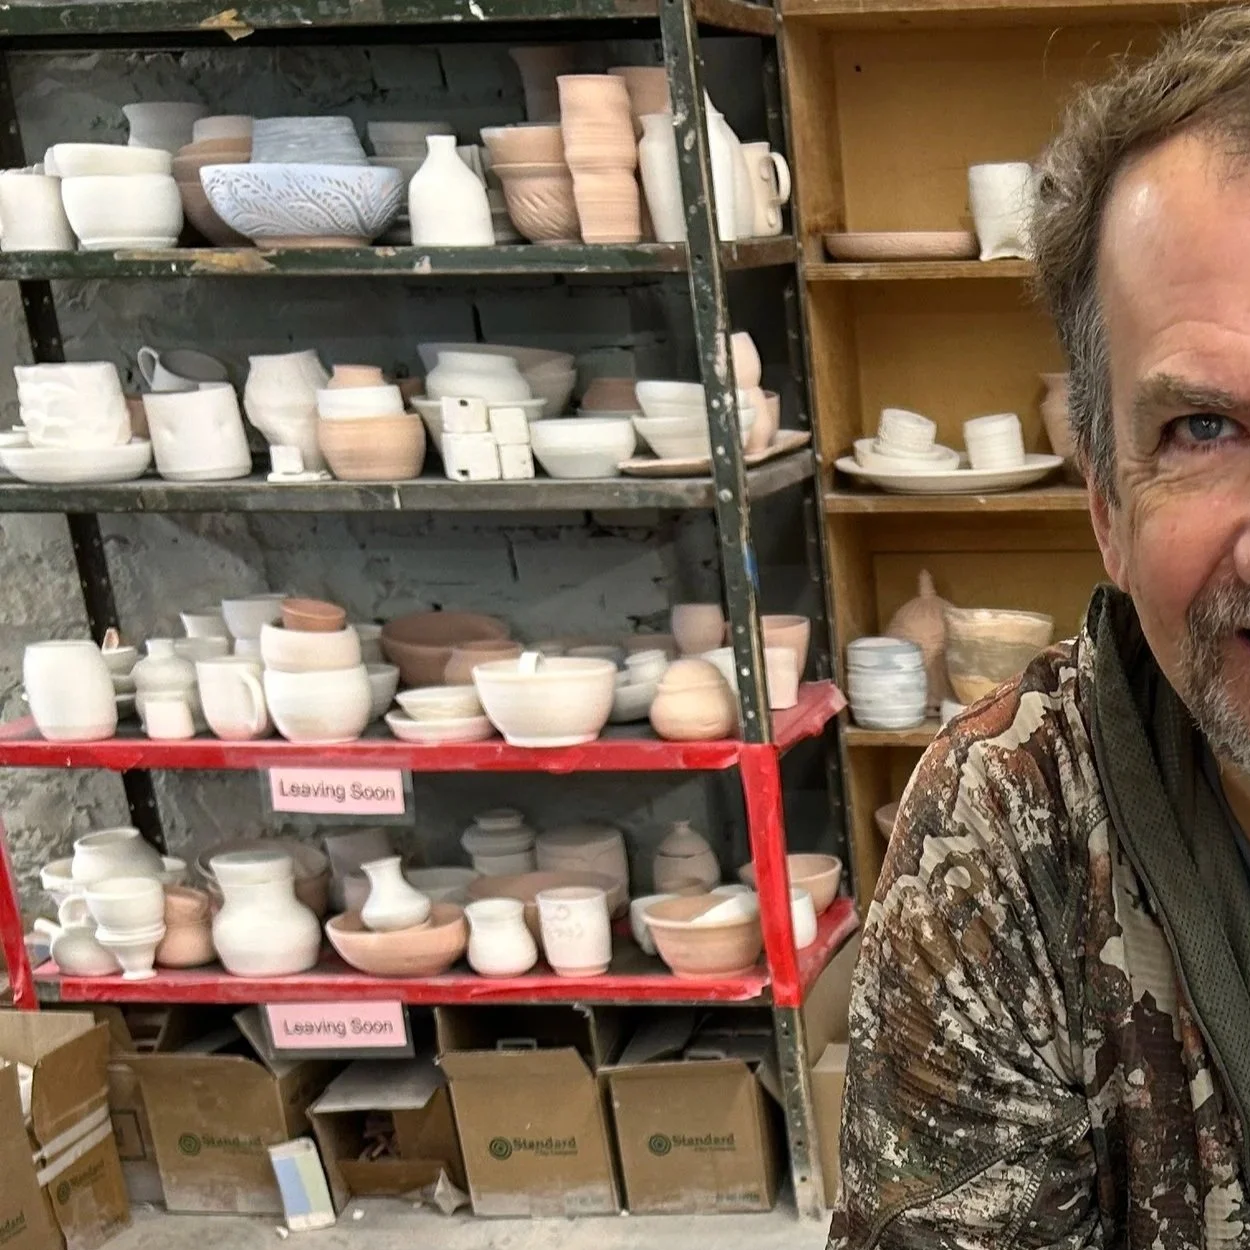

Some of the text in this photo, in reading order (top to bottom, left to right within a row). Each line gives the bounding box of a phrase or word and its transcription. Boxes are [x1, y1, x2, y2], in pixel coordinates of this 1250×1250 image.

[280, 779, 396, 803] Leaving Soon
[284, 1017, 393, 1038] Leaving Soon
[512, 1136, 577, 1151] Standard
[672, 1132, 735, 1147] Standard
